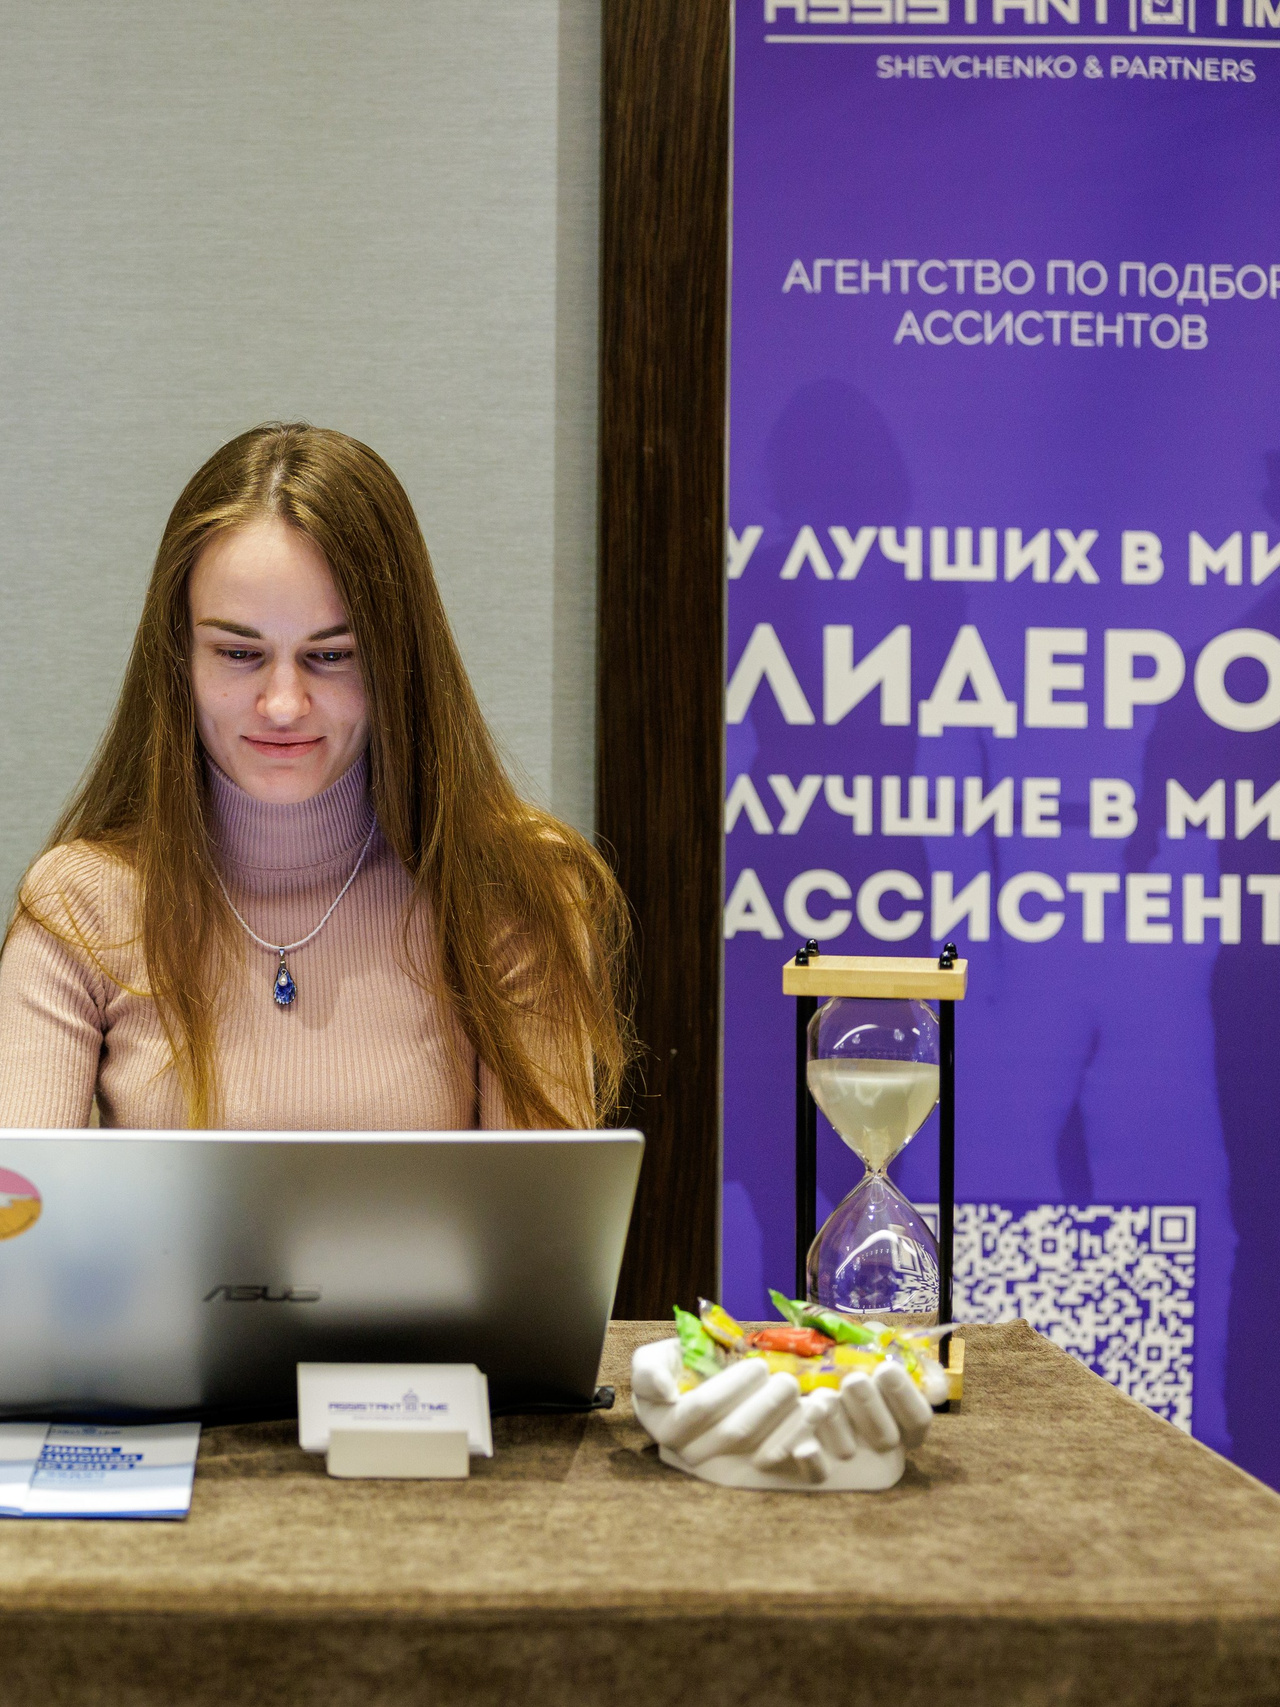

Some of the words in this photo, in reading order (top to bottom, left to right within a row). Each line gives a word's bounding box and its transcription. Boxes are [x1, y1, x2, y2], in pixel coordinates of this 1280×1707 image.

[876, 54, 1078, 80] SHEVCHENKO
[1083, 54, 1105, 80] &
[1110, 55, 1257, 84] PARTNERS
[782, 258, 1036, 295] АГЕНТСТВО
[1046, 259, 1109, 296] ПО
[893, 309, 1210, 350] АССИСТЕНТОВ
[780, 525, 1101, 585] ЛУЧШИХ
[1121, 530, 1165, 586] В
[726, 622, 1280, 739] ЛИДЕРО
[724, 773, 1062, 838] ЛУЧШИЕ
[1089, 777, 1139, 840] В
[203, 1284, 322, 1302] ASUS
